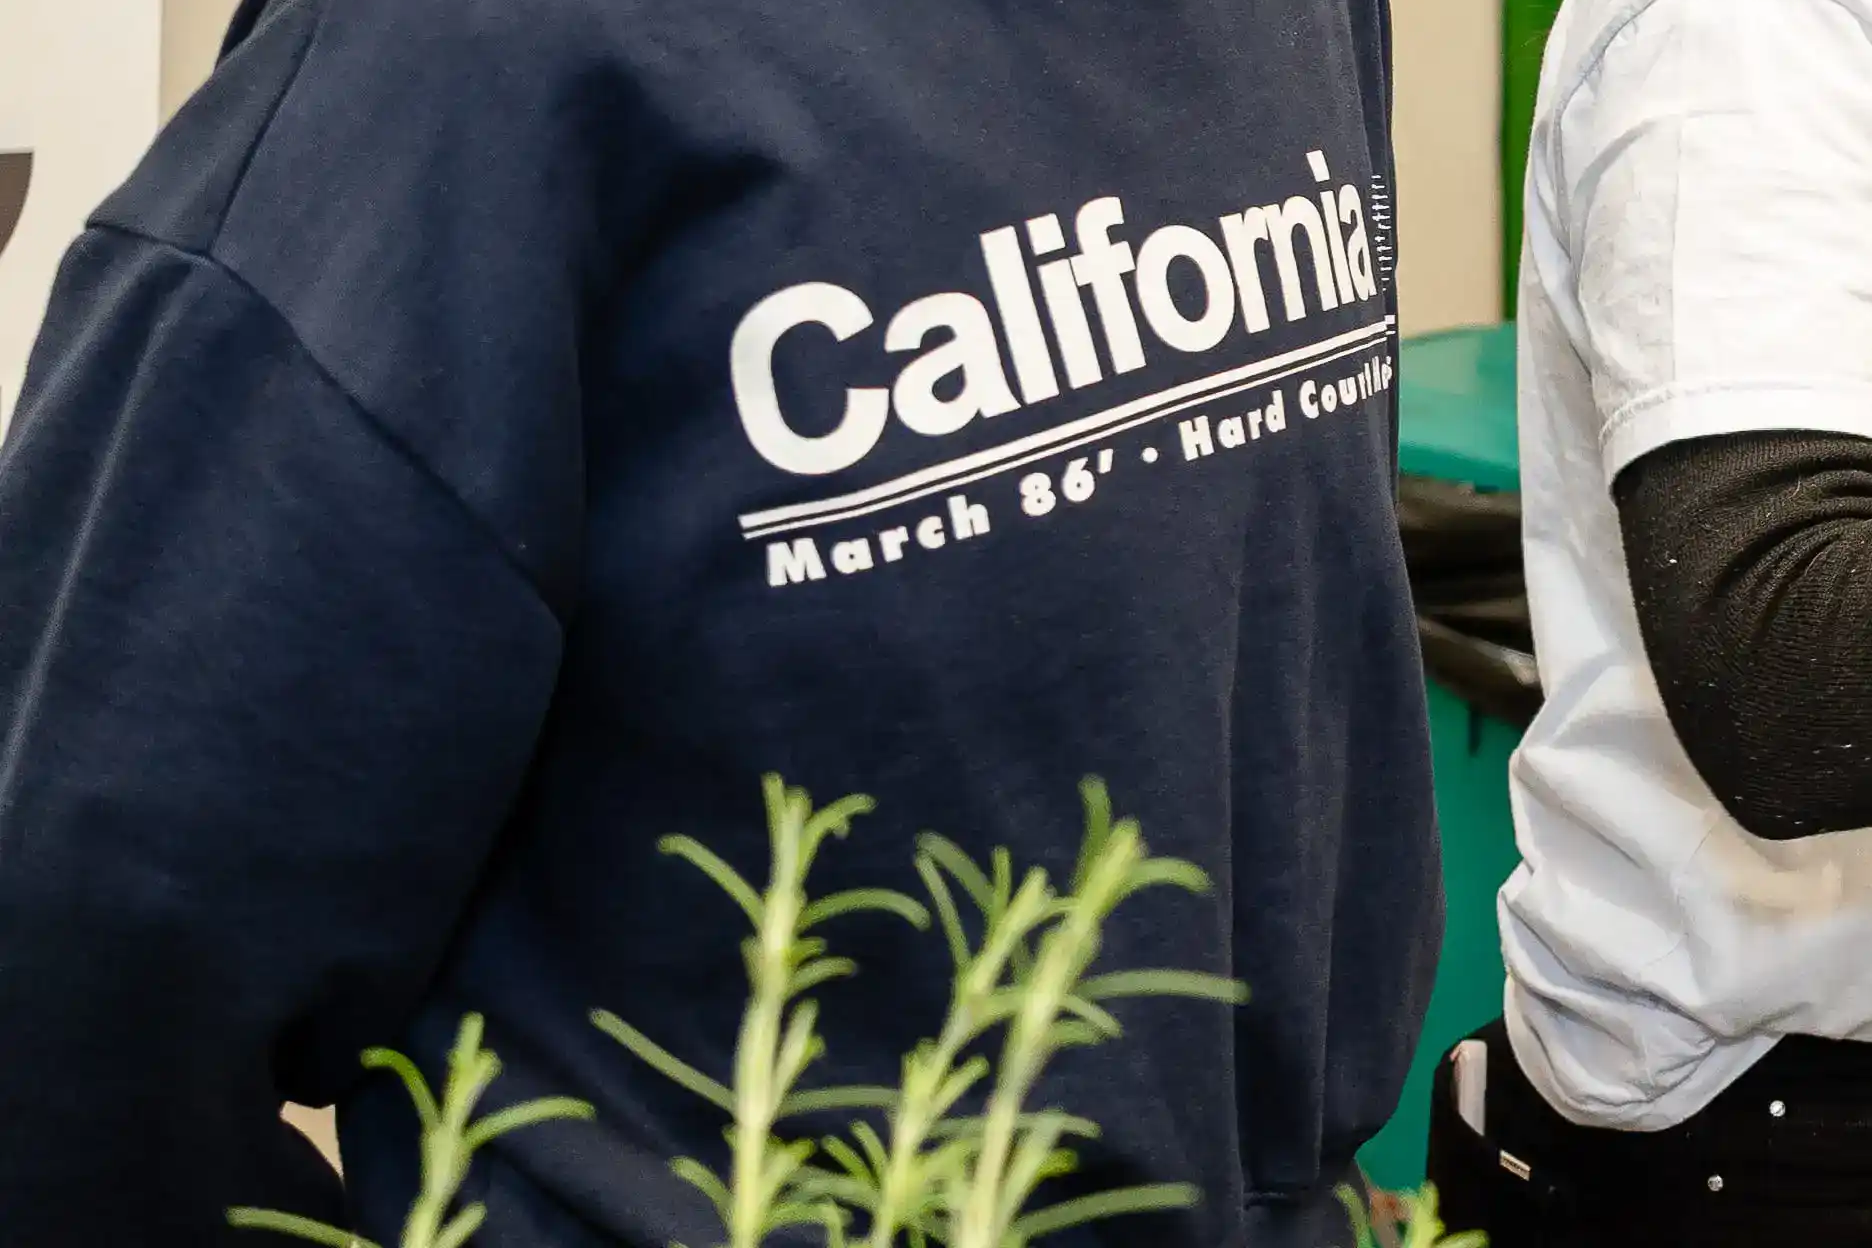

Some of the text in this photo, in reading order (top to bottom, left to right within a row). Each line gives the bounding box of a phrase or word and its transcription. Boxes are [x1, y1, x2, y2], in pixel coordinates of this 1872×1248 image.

[730, 149, 1377, 476] California
[765, 493, 992, 588] March
[1180, 390, 1287, 462] Hard
